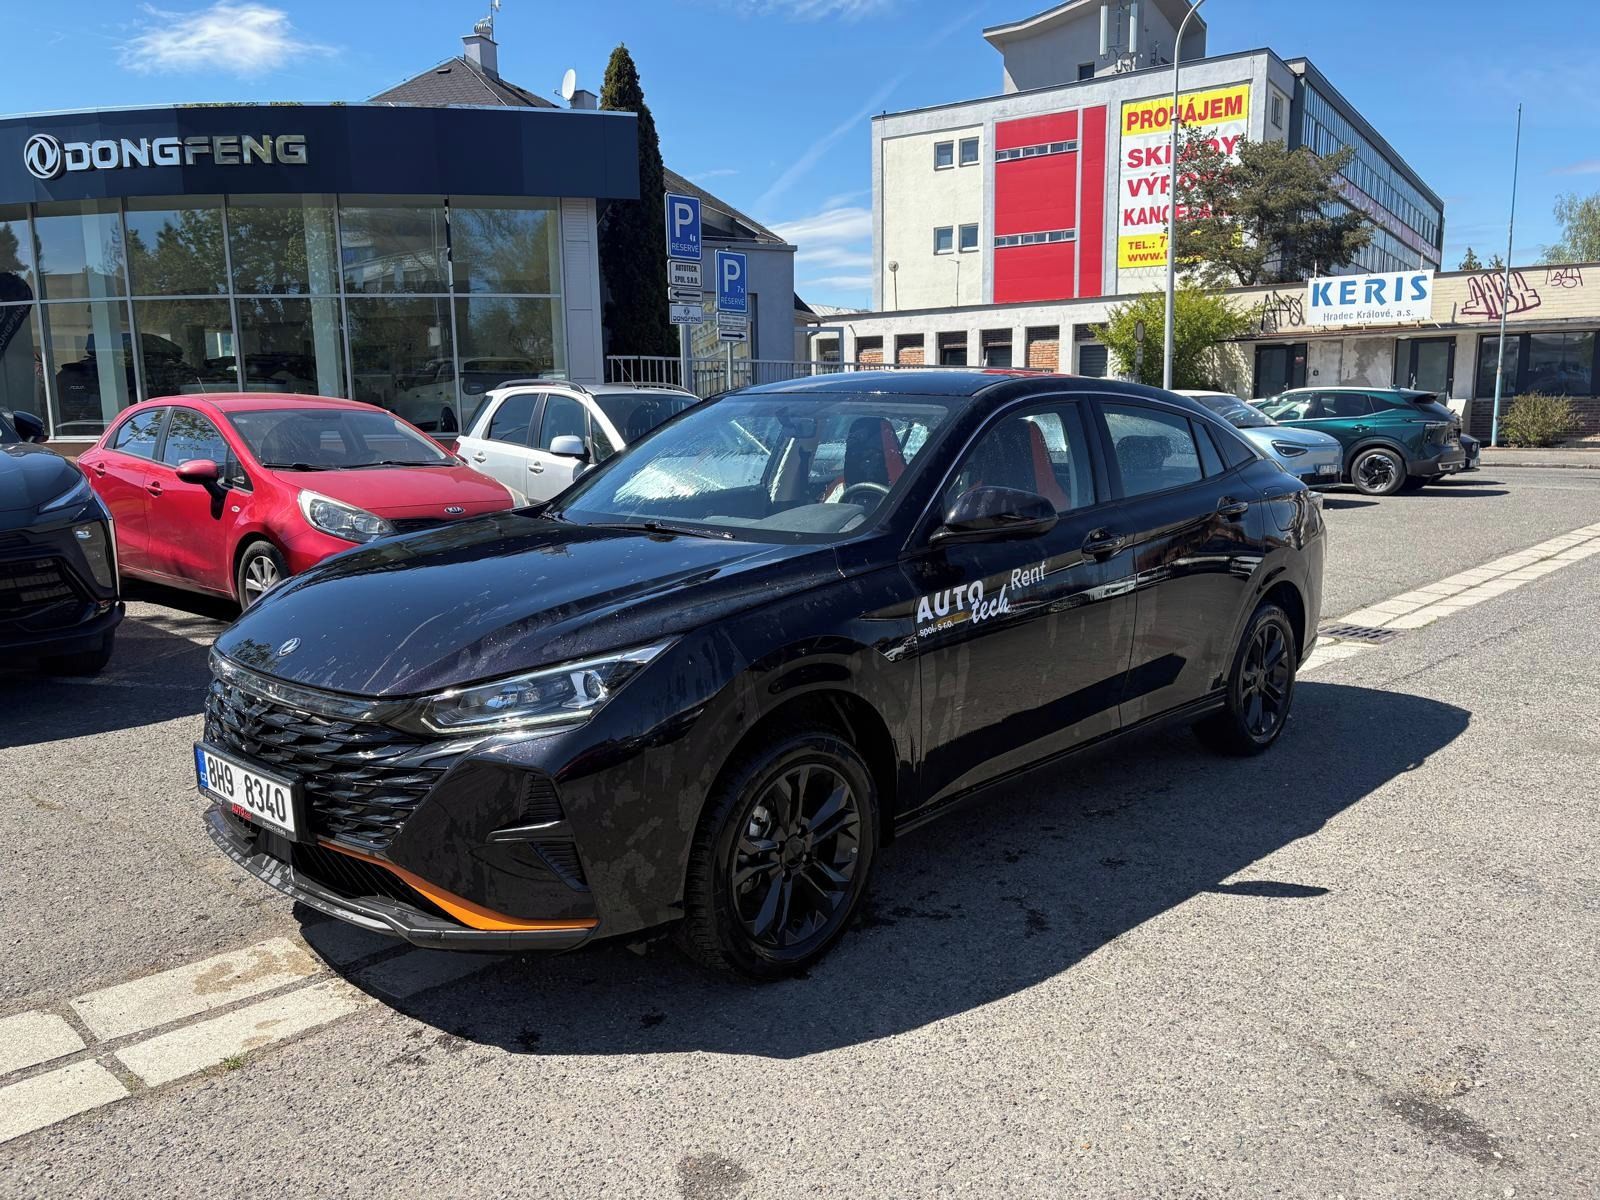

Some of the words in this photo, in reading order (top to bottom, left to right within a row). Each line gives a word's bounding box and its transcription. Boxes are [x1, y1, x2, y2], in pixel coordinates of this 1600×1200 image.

[64, 135, 307, 171] DONGFENG
[674, 202, 693, 238] P
[724, 258, 740, 293] P
[1312, 275, 1428, 307] KERIS
[1323, 311, 1355, 321] Hradec
[1356, 309, 1393, 319] Králové,
[1396, 309, 1414, 317] a.s.
[917, 580, 984, 624] AUTO
[971, 584, 1011, 624] tech
[1011, 561, 1047, 591] Rent
[207, 756, 235, 797] 8H9
[243, 773, 287, 823] 8340
